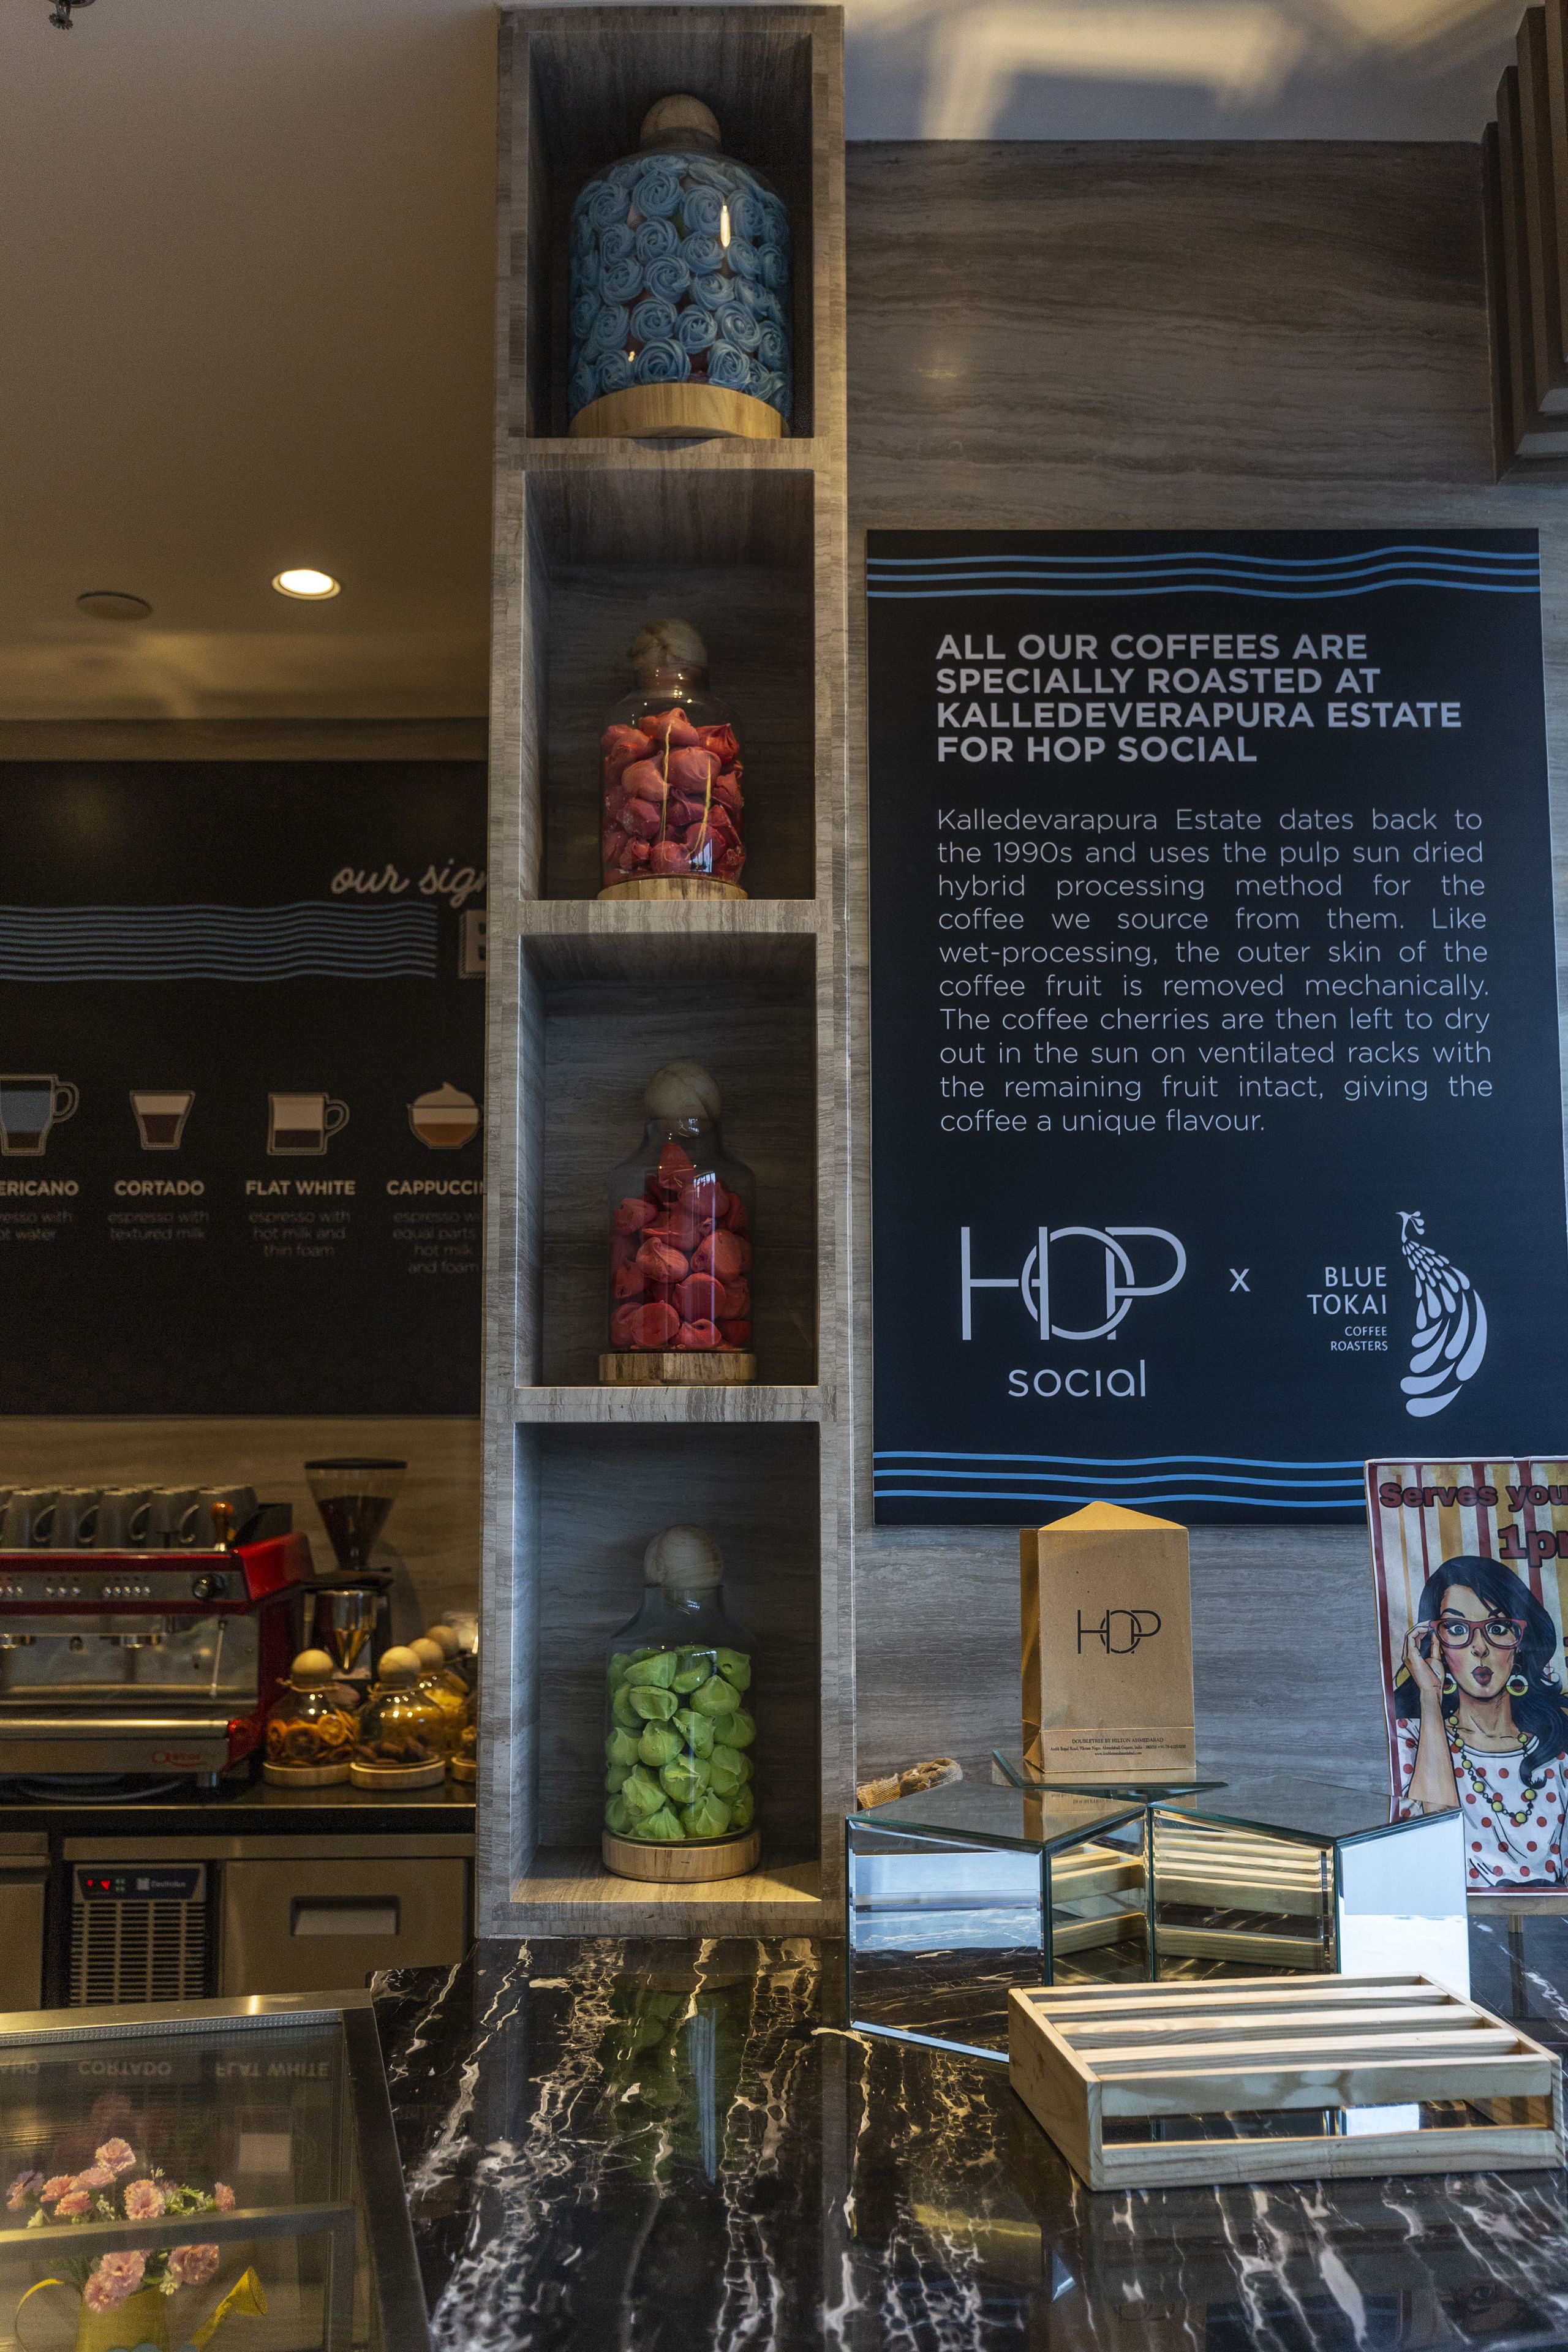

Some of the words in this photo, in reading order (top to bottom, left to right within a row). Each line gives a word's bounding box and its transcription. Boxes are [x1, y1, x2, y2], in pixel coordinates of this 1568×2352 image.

[935, 634, 1006, 660] ALL
[1018, 634, 1098, 660] OUR
[1110, 634, 1280, 660] COFFEES
[1292, 634, 1367, 660] ARE
[936, 668, 1134, 694] SPECIALLY
[1148, 668, 1322, 693] ROASTED
[1335, 668, 1381, 693] AT
[938, 702, 1314, 728] KALLEDEVERAPURA
[1327, 702, 1461, 728] ESTATE
[938, 736, 1014, 763] FOR
[1027, 736, 1106, 763] HOP
[1118, 736, 1257, 763] SOCIAL
[938, 808, 1157, 834] Kalledevarapura
[1177, 809, 1262, 830] Estate
[1279, 808, 1354, 830] dates
[1372, 807, 1437, 830] back
[1454, 809, 1482, 830] to
[937, 841, 981, 864] the
[993, 841, 1072, 864] 1990s
[1085, 841, 1136, 863] and
[1150, 846, 1210, 863] uses
[1223, 840, 1267, 863] the
[1280, 840, 1340, 867] pulp
[1353, 846, 1400, 863] sun
[1413, 840, 1483, 863] dried
[331, 864, 410, 895] our
[938, 874, 1025, 901] hybrid
[1057, 874, 1204, 900] processing
[1236, 873, 1342, 896] method
[1373, 873, 1411, 896] for
[1441, 873, 1485, 896] the
[938, 907, 1024, 930] coffee
[1051, 913, 1090, 930] we
[1117, 913, 1208, 930] source
[1235, 906, 1299, 929] from
[1327, 907, 1404, 929] them.
[1432, 907, 1487, 929] Like
[939, 941, 1158, 967] wet-processing,
[1175, 940, 1220, 963] the
[1237, 941, 1311, 963] outer
[1329, 940, 1381, 963] skin
[1399, 940, 1427, 963] of
[1444, 940, 1488, 963] the
[939, 974, 1025, 997] coffee
[1046, 973, 1102, 997] fruit
[1123, 974, 1142, 997] is
[1164, 973, 1283, 997] removed
[1305, 973, 1488, 1000] mechanically.
[939, 1008, 990, 1030] The
[1002, 1007, 1088, 1030] coffee
[1100, 1007, 1210, 1030] cherries
[1221, 1012, 1264, 1030] are
[1275, 1006, 1336, 1030] then
[1350, 1006, 1393, 1030] left
[1404, 1009, 1433, 1030] to
[1445, 1006, 1490, 1034] dry
[940, 1042, 986, 1064] out
[999, 1041, 1021, 1063] in
[1034, 1041, 1079, 1064] the
[1091, 1047, 1138, 1064] sun
[1151, 1046, 1185, 1064] on
[1198, 1040, 1334, 1063] ventilated
[1348, 1040, 1420, 1063] racks
[1432, 1040, 1491, 1063] with
[940, 1075, 984, 1098] the
[1005, 1075, 1141, 1102] remaining
[1162, 1074, 1218, 1098] fruit
[1239, 1075, 1323, 1099] intact,
[1344, 1075, 1428, 1101] giving
[1448, 1074, 1493, 1097] the
[940, 1109, 1027, 1132] coffee
[1036, 1115, 1052, 1132] a
[1063, 1109, 1156, 1136] unique
[1166, 1108, 1264, 1131] flavour.
[114, 1180, 205, 1196] CORTADO
[245, 1180, 291, 1196] FLAT
[295, 1180, 356, 1196] WHITE
[961, 1226, 1187, 1341] HOP
[1324, 1266, 1387, 1288] BLUE
[1306, 1294, 1387, 1316] TOKAI
[1344, 1326, 1388, 1337] COFFEE
[1330, 1340, 1389, 1352] ROASTERS
[1008, 1359, 1147, 1398] social
[1379, 1481, 1498, 1508] Serves
[1077, 1609, 1162, 1654] HOP
